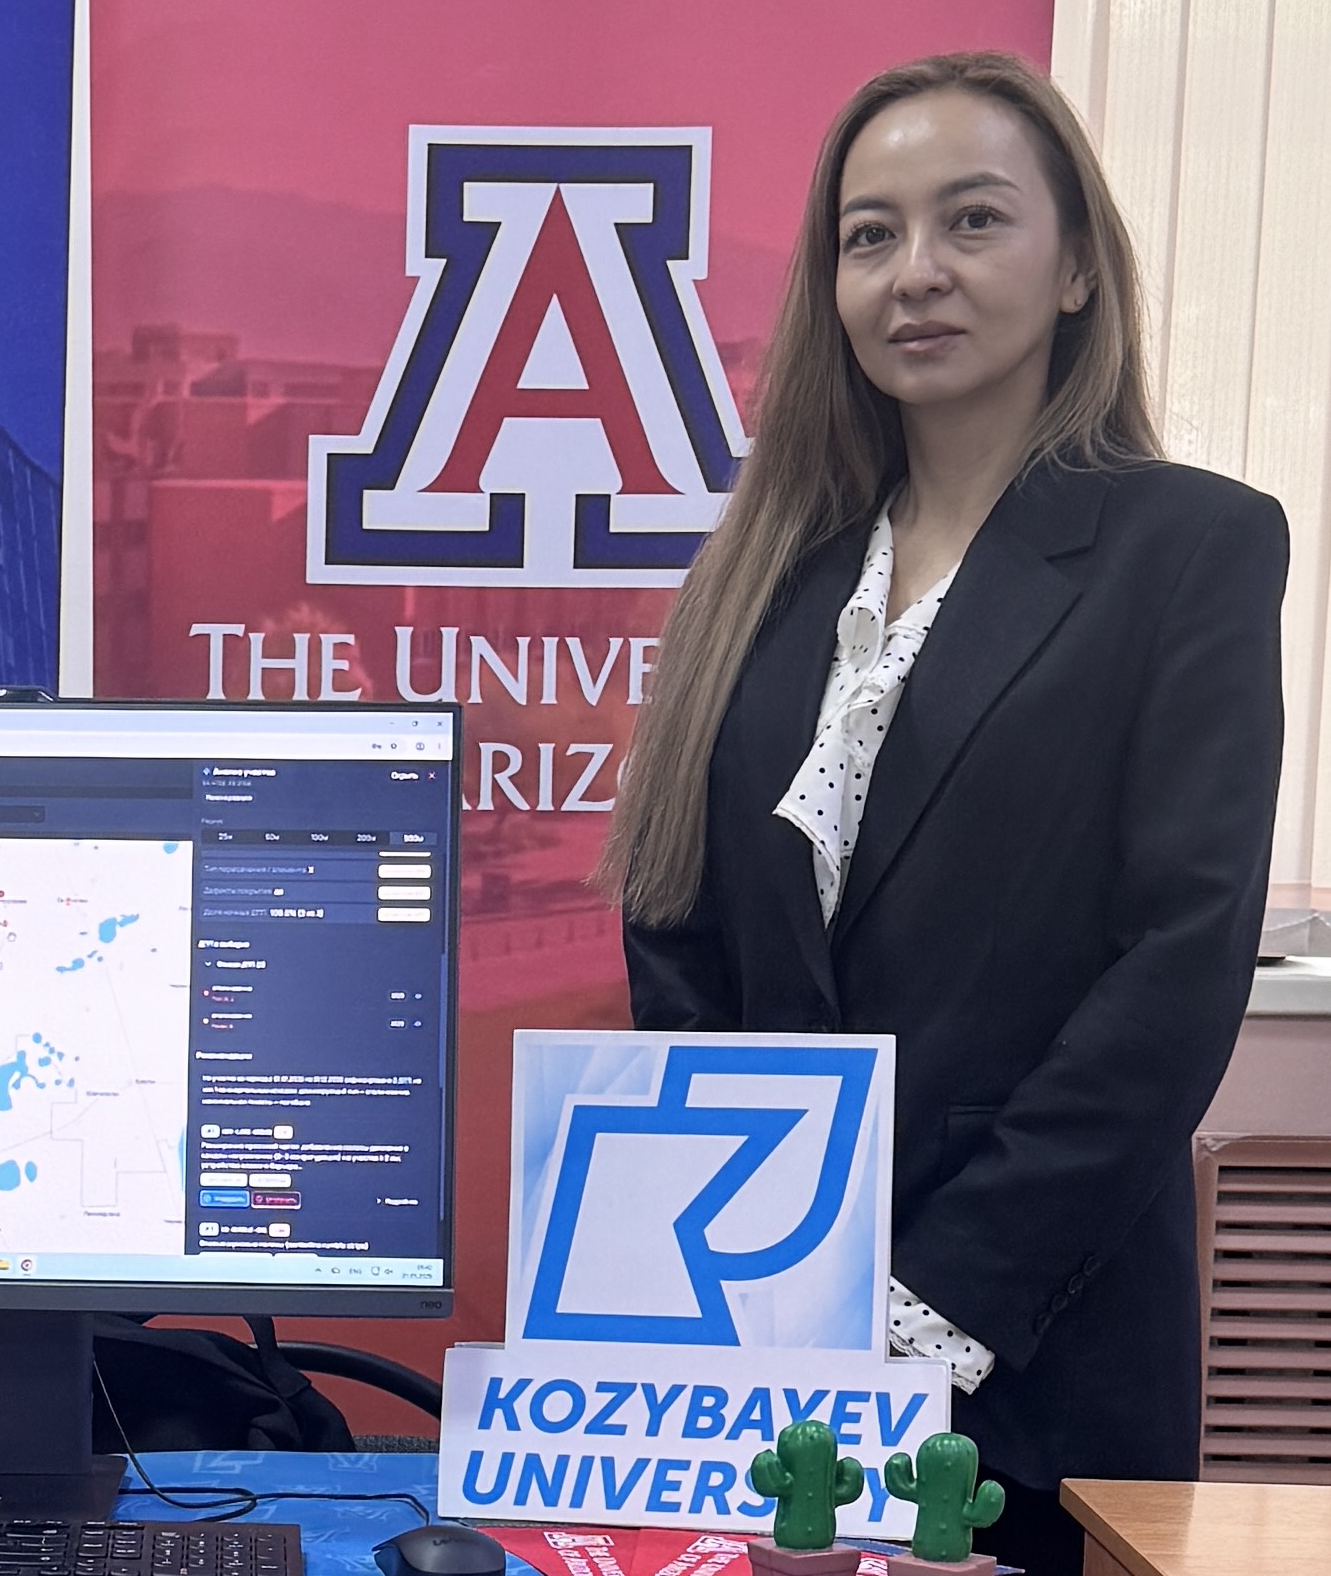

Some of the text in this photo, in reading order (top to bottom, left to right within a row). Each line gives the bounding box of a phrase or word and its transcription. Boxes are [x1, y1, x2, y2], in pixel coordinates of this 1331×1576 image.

[310, 128, 748, 583] A
[189, 623, 662, 707] THE UNIVE
[462, 742, 626, 812] RIZ
